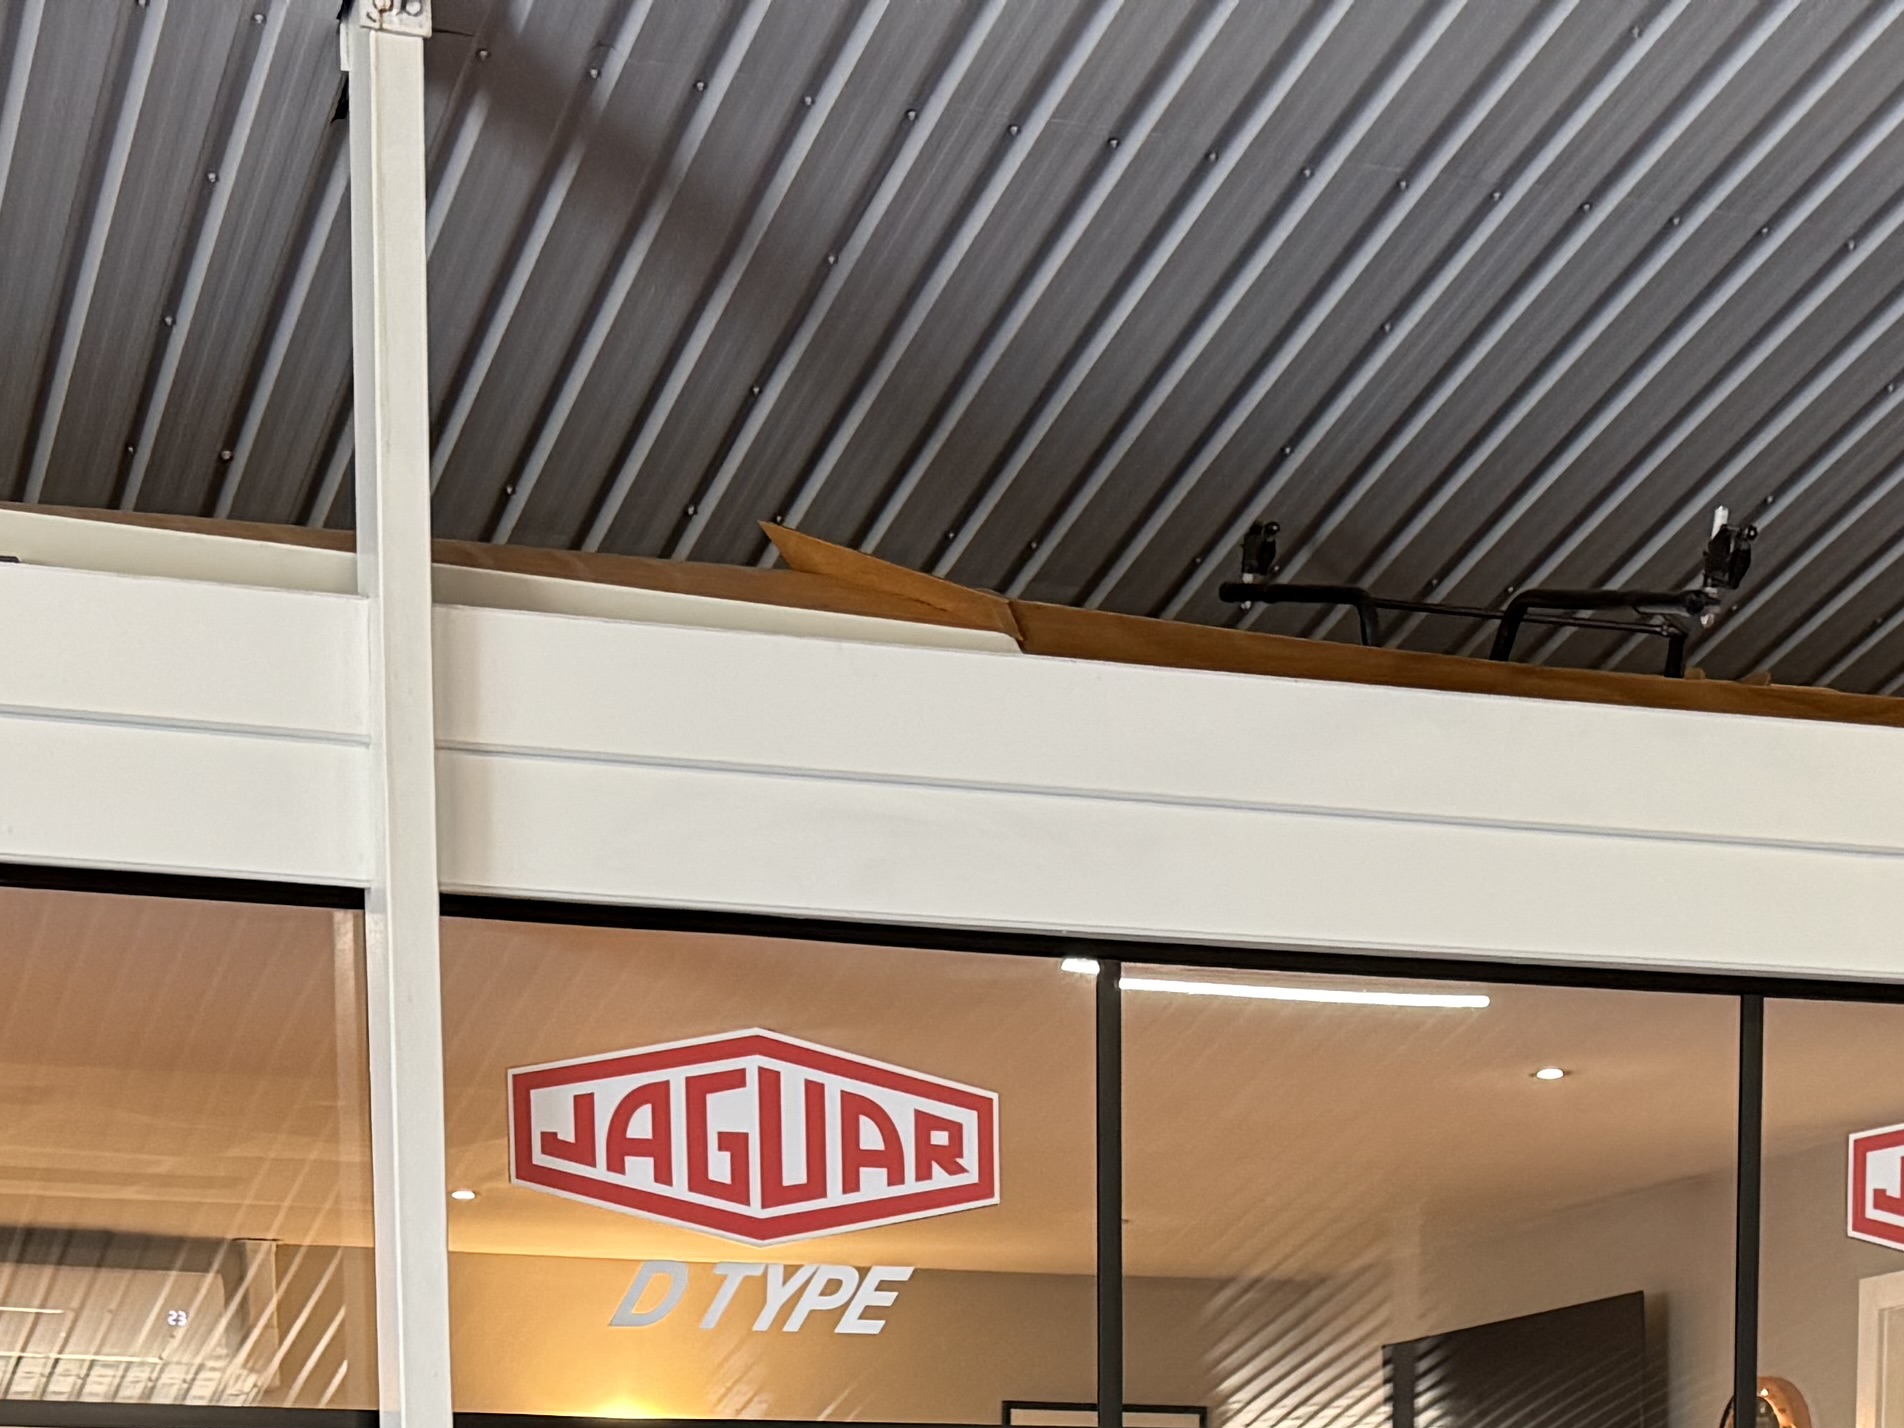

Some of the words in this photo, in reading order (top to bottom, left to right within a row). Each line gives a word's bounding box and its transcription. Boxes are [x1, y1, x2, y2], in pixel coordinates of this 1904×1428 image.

[541, 1068, 970, 1209] JAGUAR
[168, 1310, 187, 1326] 23
[609, 1260, 689, 1329] D
[700, 1262, 915, 1335] TYPE
